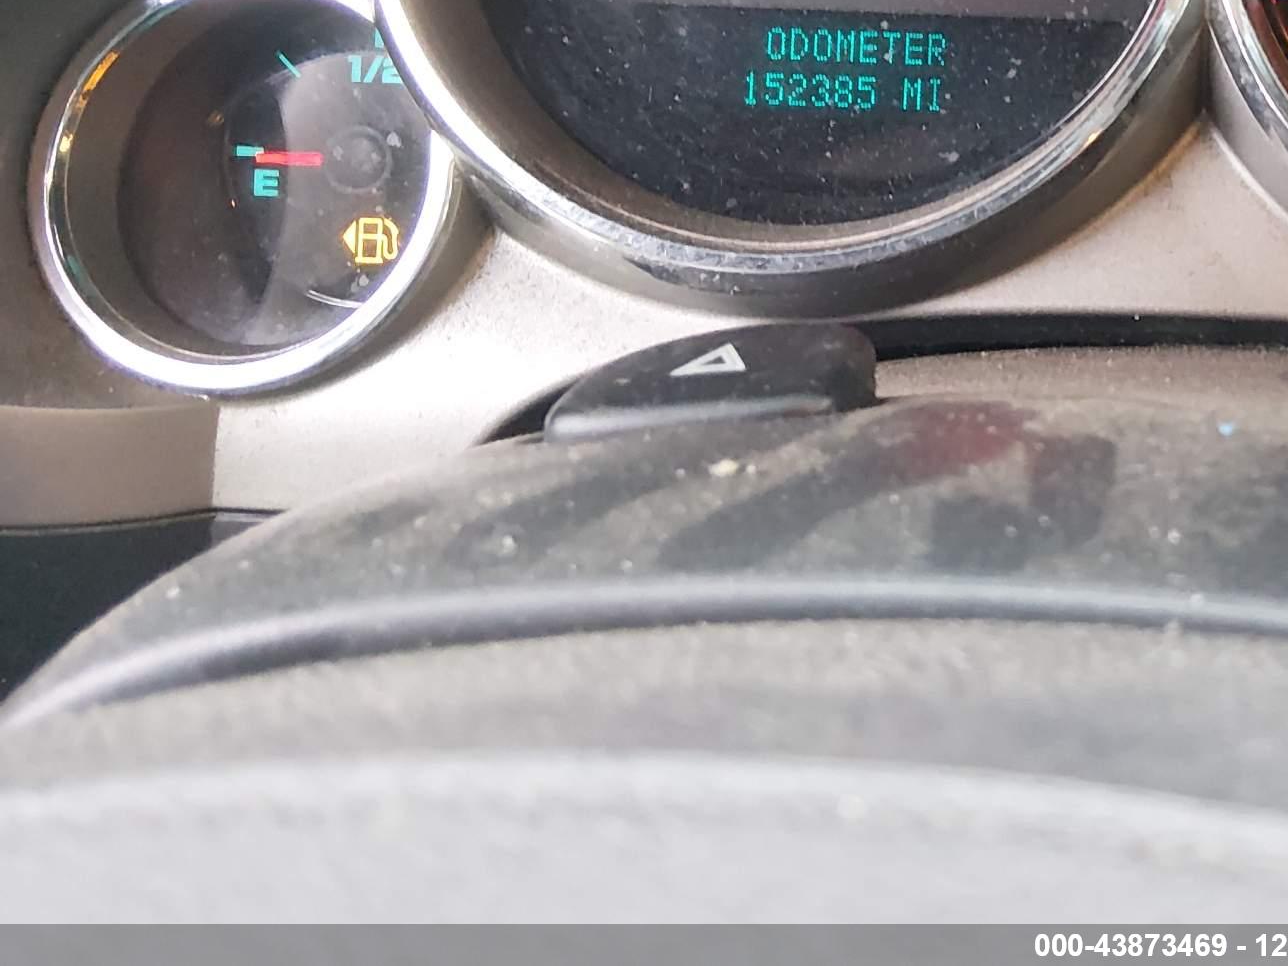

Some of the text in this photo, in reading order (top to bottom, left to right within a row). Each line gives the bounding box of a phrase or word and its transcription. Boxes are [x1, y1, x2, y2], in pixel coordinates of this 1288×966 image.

[766, 26, 947, 66] ODOMETER
[744, 71, 942, 112] 152385 MI
[253, 169, 280, 198] E
